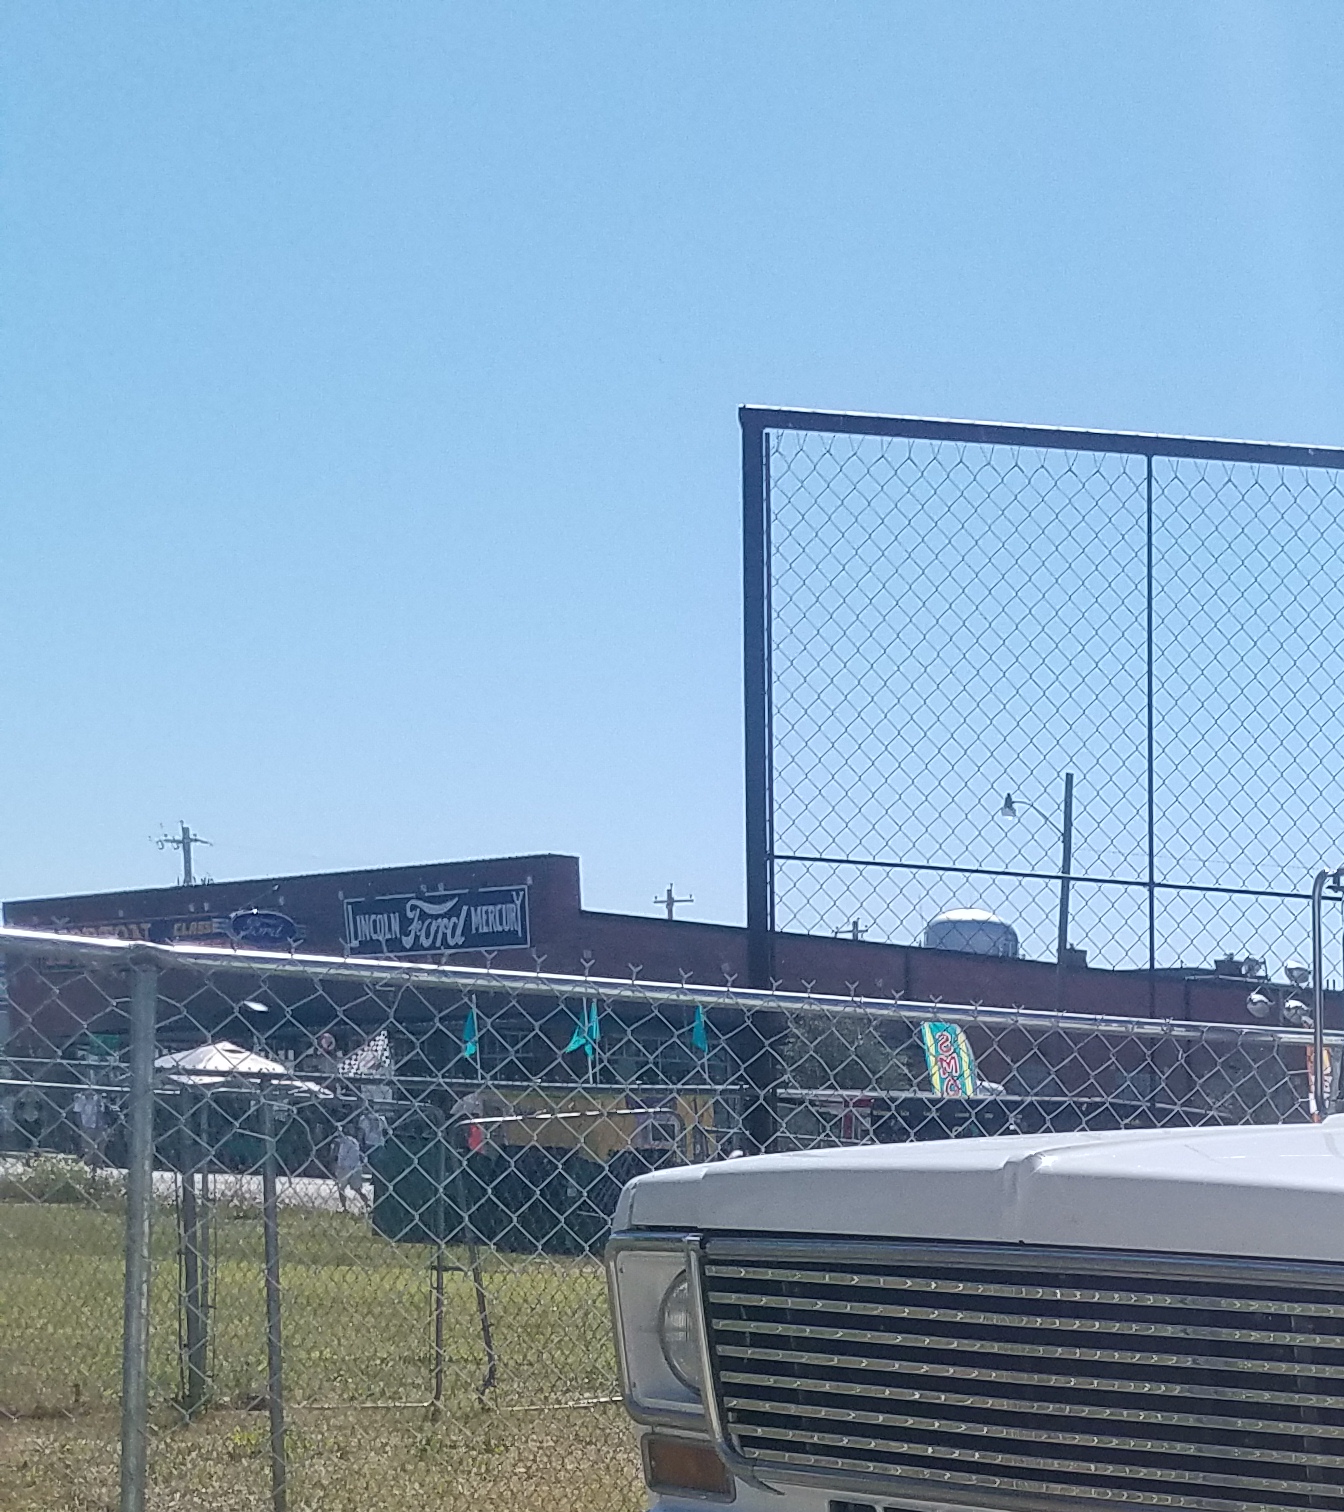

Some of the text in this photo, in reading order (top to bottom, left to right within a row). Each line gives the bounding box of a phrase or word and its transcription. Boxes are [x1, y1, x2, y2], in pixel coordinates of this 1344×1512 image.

[346, 891, 524, 949] LINCOLN Ford MERCURY
